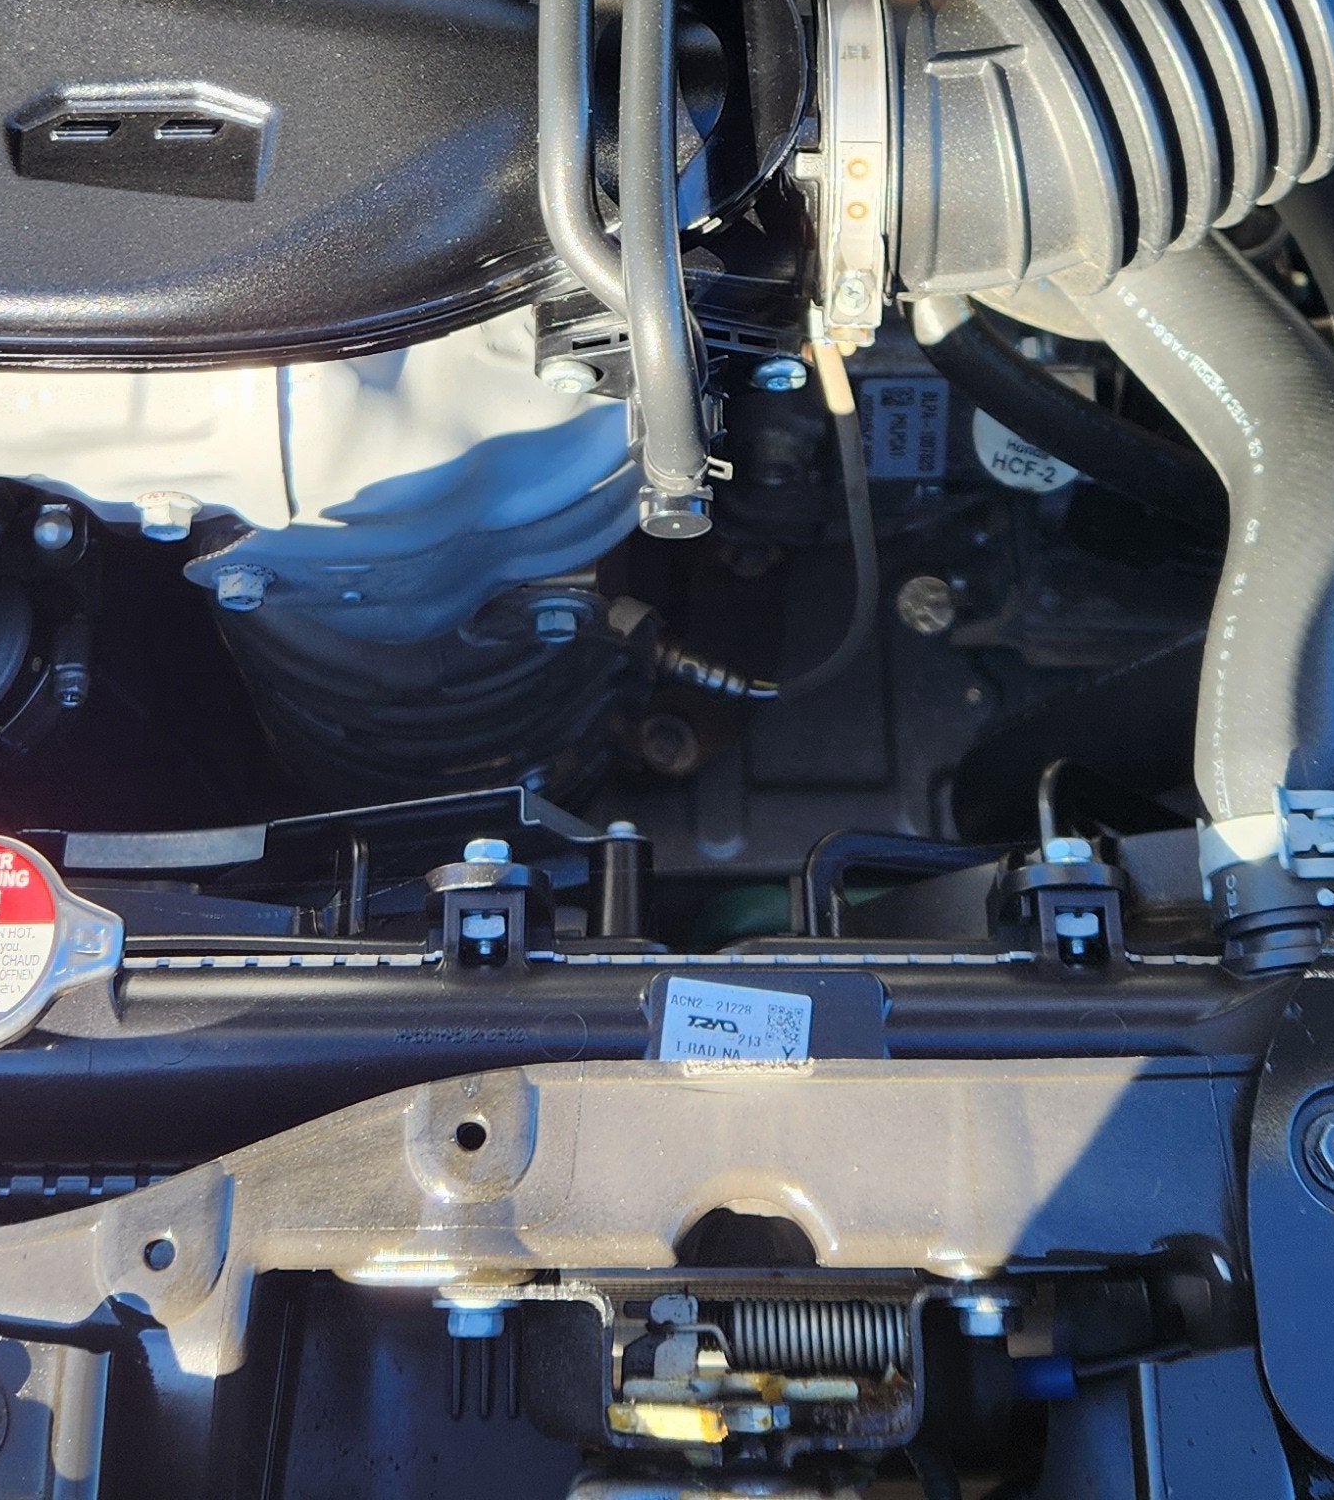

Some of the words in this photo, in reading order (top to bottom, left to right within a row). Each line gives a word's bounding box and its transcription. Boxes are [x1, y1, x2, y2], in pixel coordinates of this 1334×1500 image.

[992, 451, 1057, 484] HCF-2
[8, 927, 36, 939] HOT.
[1, 954, 41, 967] CHAUD
[722, 1047, 741, 1060] NA
